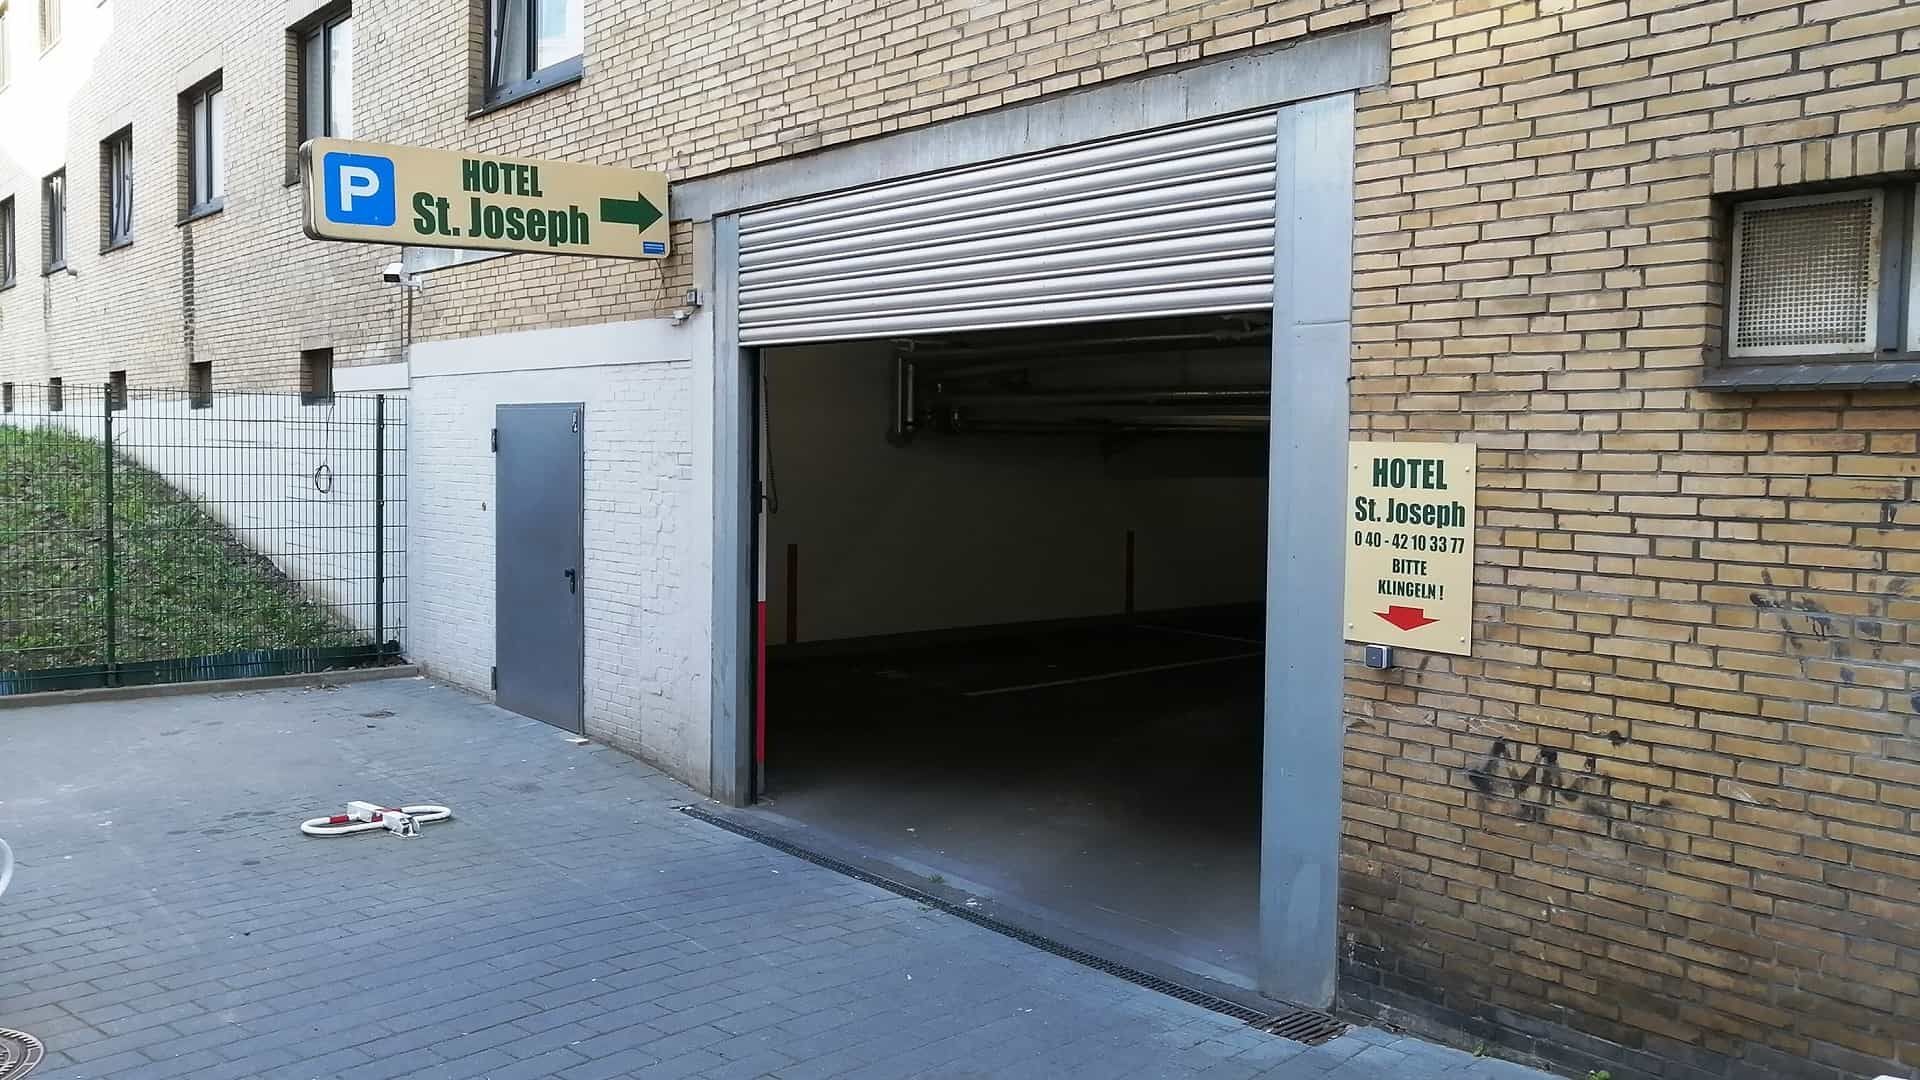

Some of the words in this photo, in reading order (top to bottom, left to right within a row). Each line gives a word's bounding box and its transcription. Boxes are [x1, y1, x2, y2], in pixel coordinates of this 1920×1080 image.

[339, 166, 380, 212] P
[462, 159, 543, 198] HOTEL
[412, 192, 460, 237] St.
[468, 197, 590, 247] Joseph
[1372, 458, 1448, 490] HOTEL
[1355, 496, 1381, 522] St.
[1386, 498, 1466, 529] Joseph
[1392, 558, 1428, 576] BITTE
[1377, 580, 1437, 600] KLINGELN
